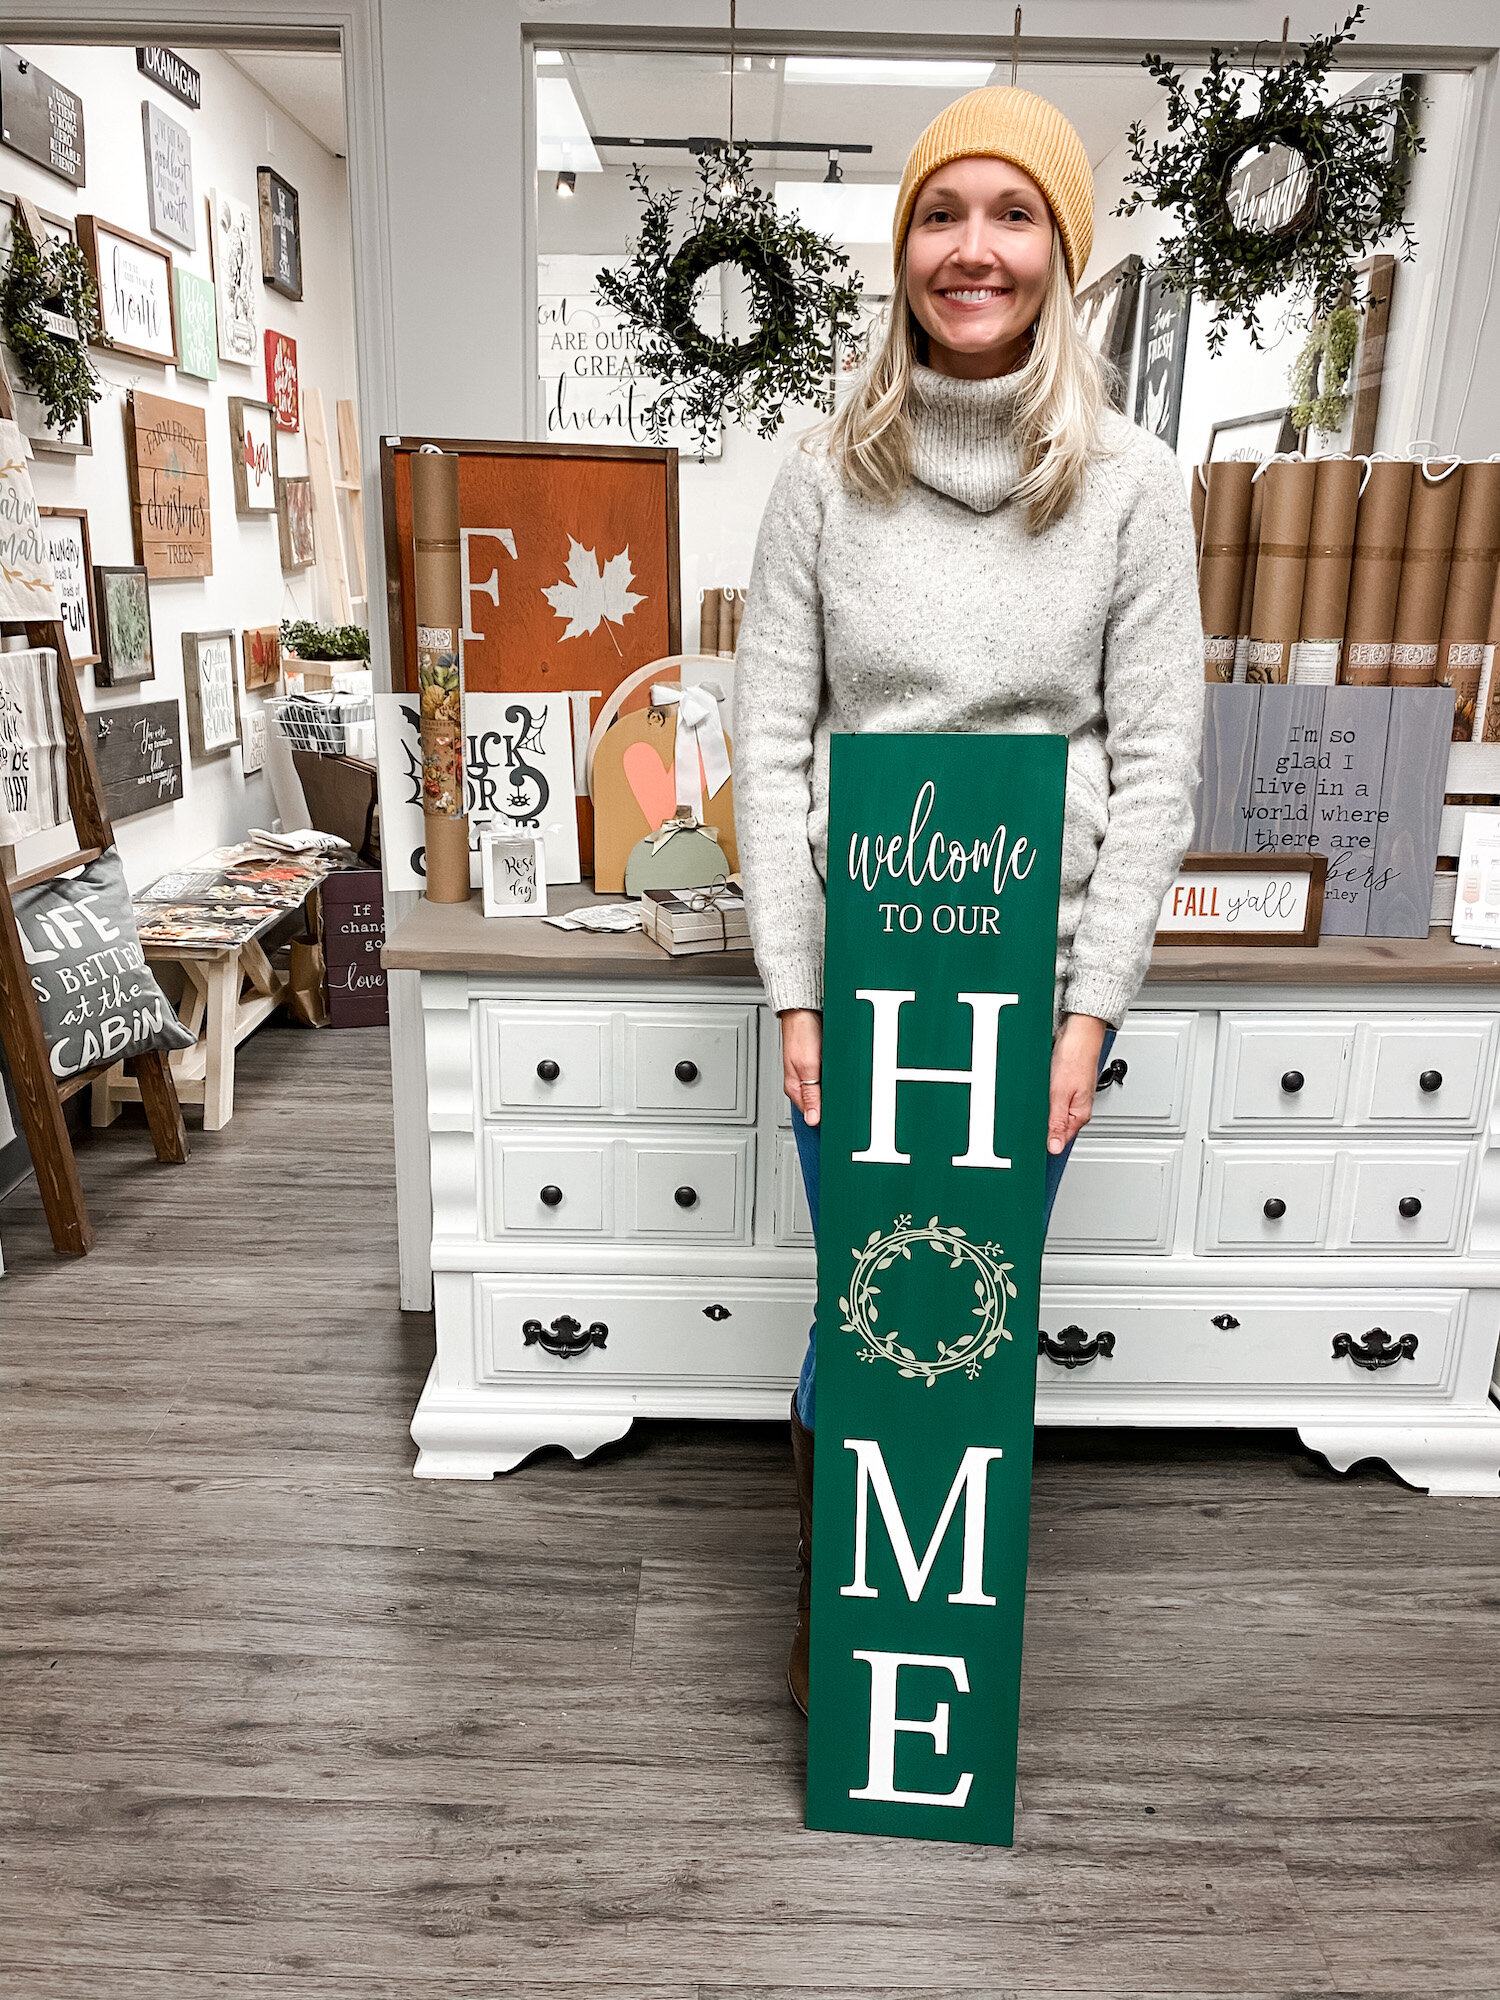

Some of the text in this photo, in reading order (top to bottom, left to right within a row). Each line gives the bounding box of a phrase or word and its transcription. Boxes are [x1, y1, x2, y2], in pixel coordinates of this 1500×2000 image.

[48, 95, 77, 125] PATIENT
[50, 110, 78, 138] STRONG
[53, 125, 73, 147] HERO
[49, 136, 81, 166] RELIABLE
[50, 150, 76, 175] FRIEND
[111, 246, 162, 337] home
[551, 332, 638, 350] ARE OUR
[147, 420, 200, 463] FARM FRESH
[148, 469, 206, 536] christmas
[167, 544, 193, 564] TREES
[61, 598, 86, 632] FUN
[1289, 725, 1355, 743] I'm so
[1276, 752, 1354, 774] glad I
[1255, 778, 1369, 797] live in a
[1241, 804, 1390, 823] world where
[848, 780, 1037, 895] welcome
[1254, 828, 1320, 847] there
[1330, 833, 1371, 848] are
[509, 879, 532, 902] day
[1173, 882, 1297, 922] FALL y'all
[353, 904, 372, 917] If
[878, 903, 1000, 935] TO OUR
[56, 942, 145, 994] BETTER
[334, 962, 385, 991] love
[59, 975, 142, 1026] at the
